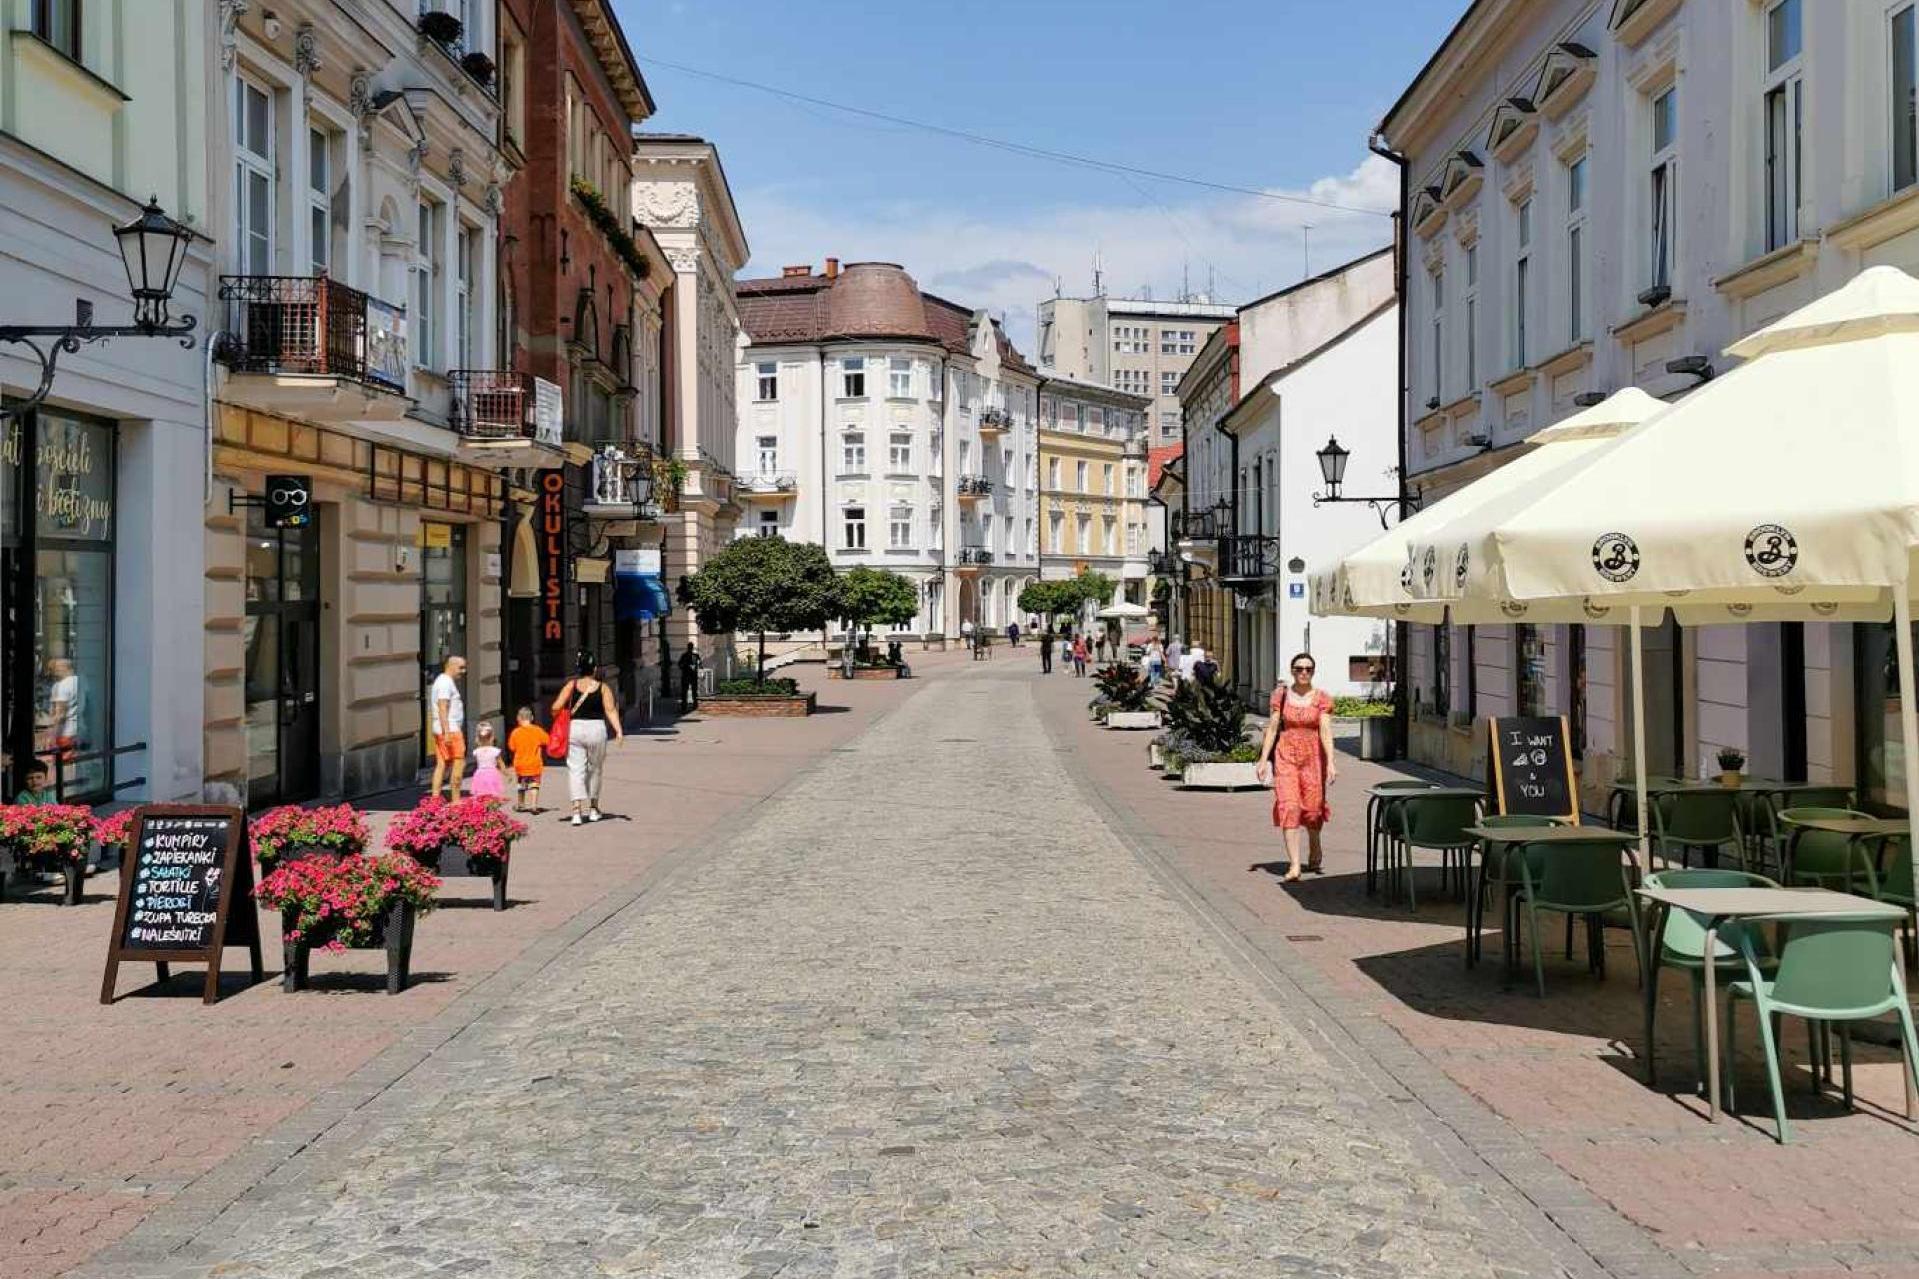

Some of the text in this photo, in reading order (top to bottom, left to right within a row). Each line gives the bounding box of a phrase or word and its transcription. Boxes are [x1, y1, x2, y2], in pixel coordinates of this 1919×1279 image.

[543, 473, 563, 639] OKULISTA
[1510, 731, 1553, 747] I WANT
[1520, 784, 1545, 798] YOU
